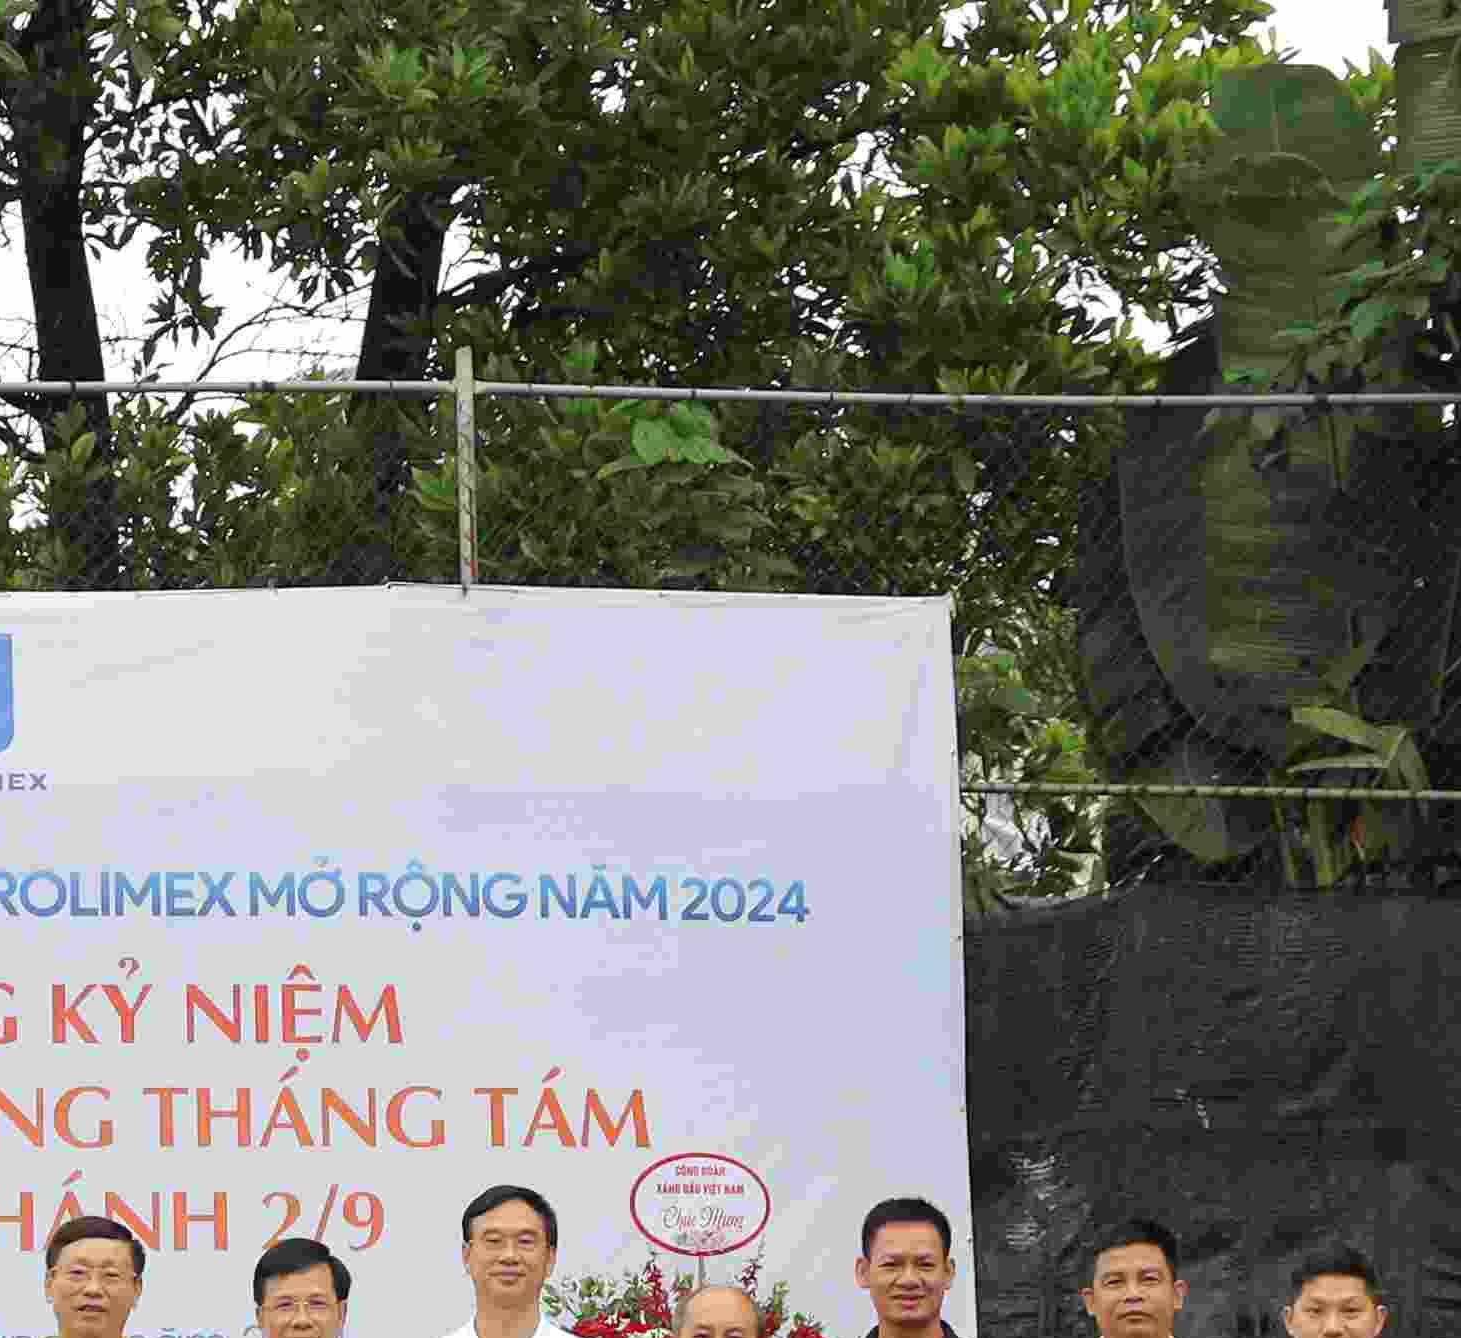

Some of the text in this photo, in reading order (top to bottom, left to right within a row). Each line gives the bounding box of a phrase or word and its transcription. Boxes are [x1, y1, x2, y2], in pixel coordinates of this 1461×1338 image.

[248, 856, 345, 918] MỞ
[357, 860, 528, 932] RỘNG
[539, 862, 668, 922] NĂM
[680, 877, 811, 923] 2024
[51, 959, 153, 1044] KỶ
[184, 962, 404, 1061] NIỆM
[142, 1064, 447, 1149] THÁNG
[473, 1064, 653, 1149] TÁM
[259, 1182, 385, 1253] 2/9
